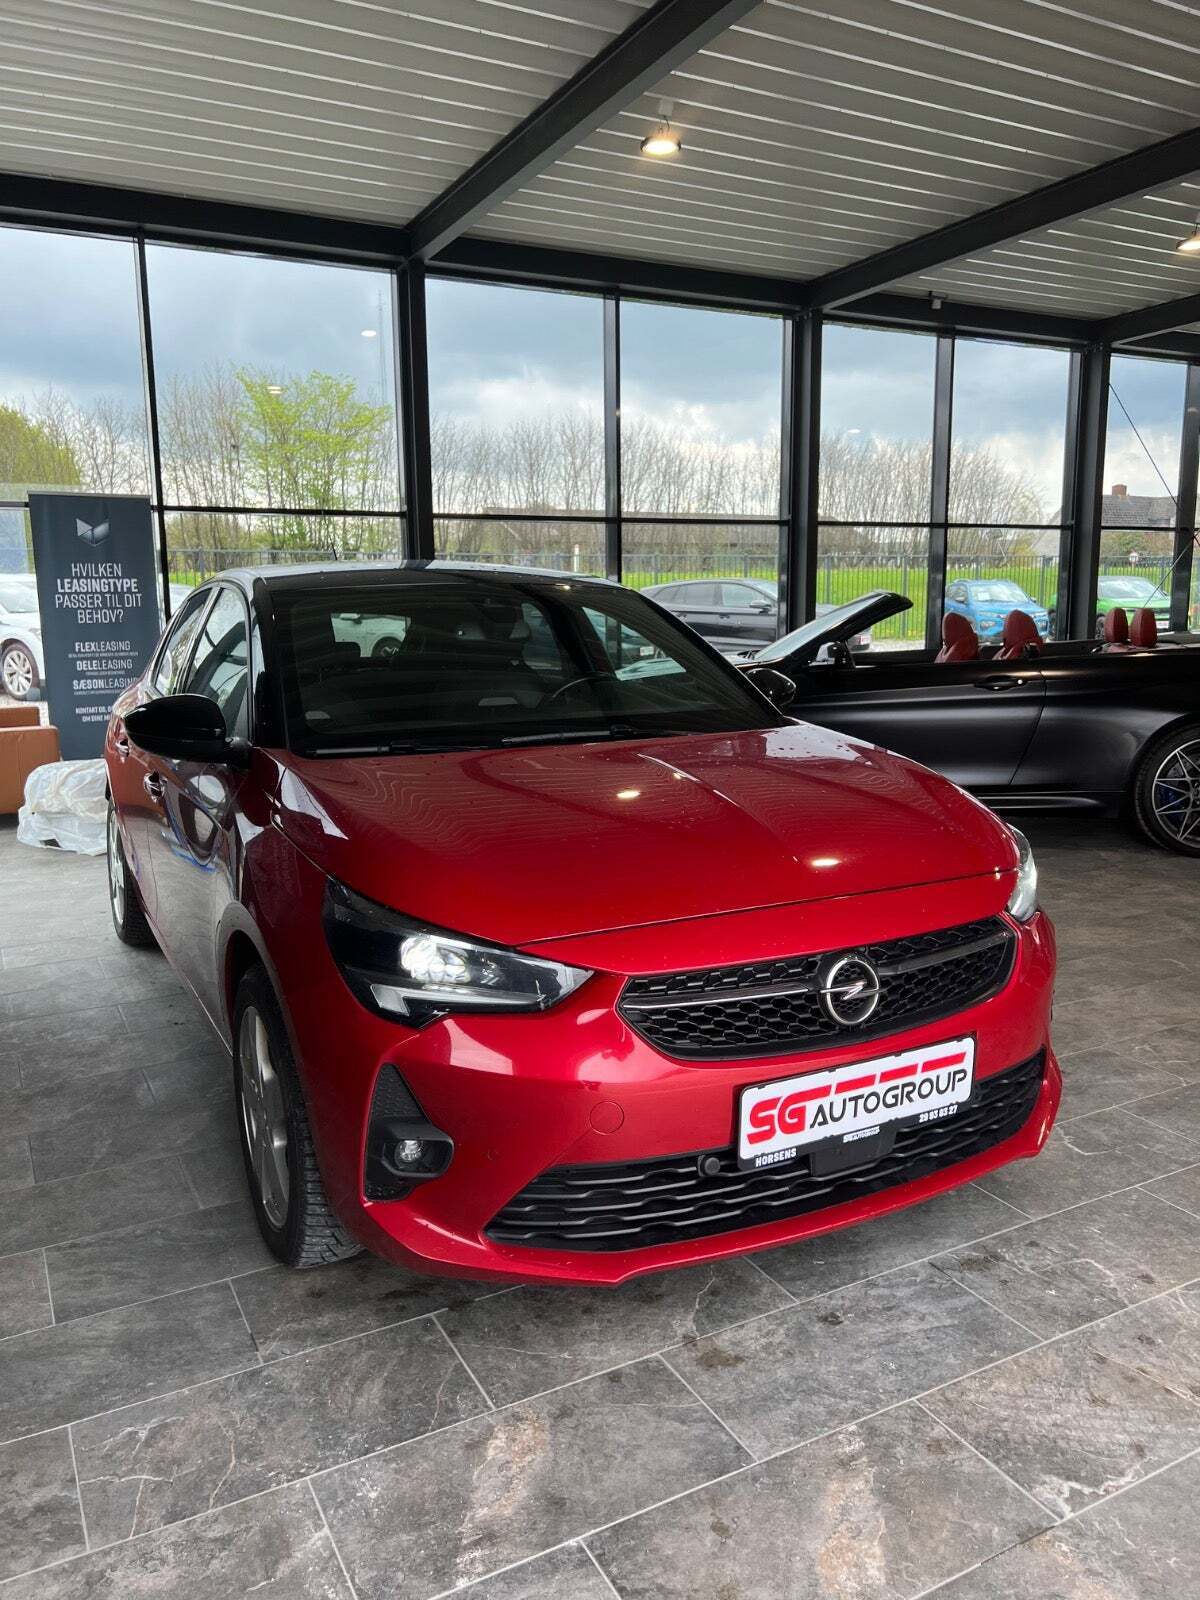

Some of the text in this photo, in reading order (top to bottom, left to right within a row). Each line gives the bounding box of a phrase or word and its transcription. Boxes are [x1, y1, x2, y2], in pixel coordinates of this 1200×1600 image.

[71, 562, 122, 577] HVILKEN
[56, 578, 139, 593] LEASINGTYPE
[55, 593, 142, 608] PASSER TIL DIT
[77, 609, 124, 624] BEHOV?
[75, 640, 131, 652] FLEXLEASING
[76, 659, 133, 671] DELELEASING
[747, 1068, 968, 1145] SG AUTOGROUP
[755, 1147, 797, 1168] HORSENS
